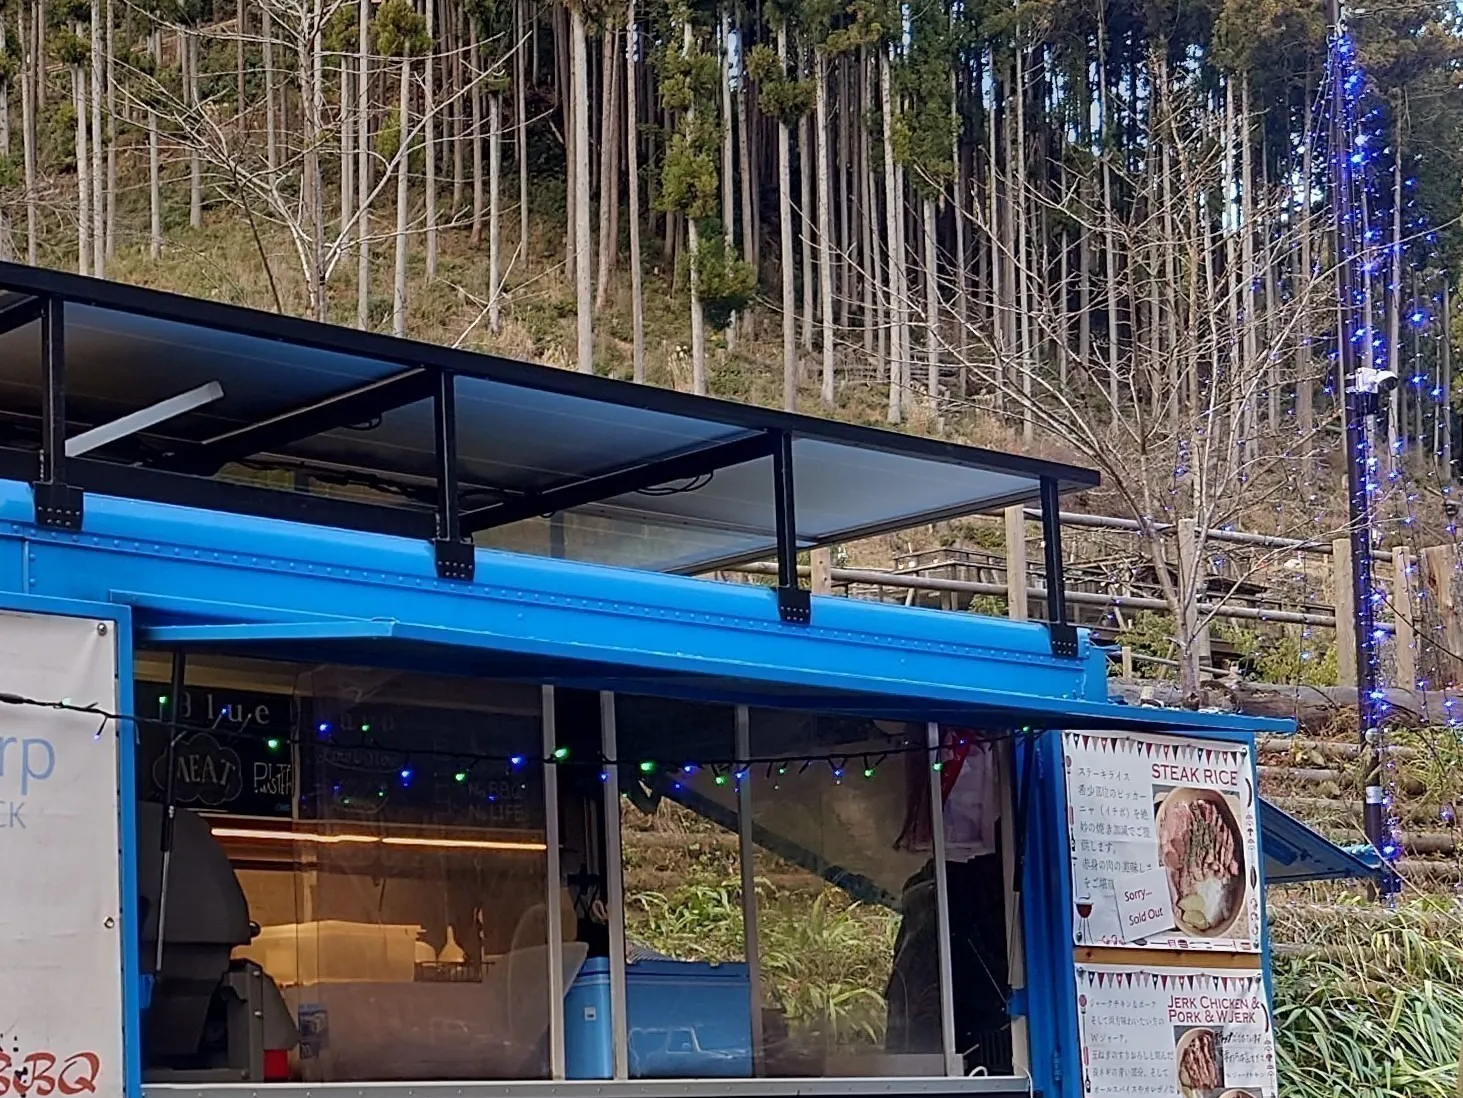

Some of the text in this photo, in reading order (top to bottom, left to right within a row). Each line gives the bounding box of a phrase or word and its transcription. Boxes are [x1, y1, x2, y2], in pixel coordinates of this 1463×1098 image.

[1077, 767, 1131, 782] ステーキライス
[1152, 765, 1238, 786] STEAK RICE
[1129, 907, 1164, 926] Sold Out
[1168, 995, 1260, 1010] JERK CHICKEN &
[1168, 1010, 1201, 1023] PORK
[1205, 1010, 1214, 1023] &
